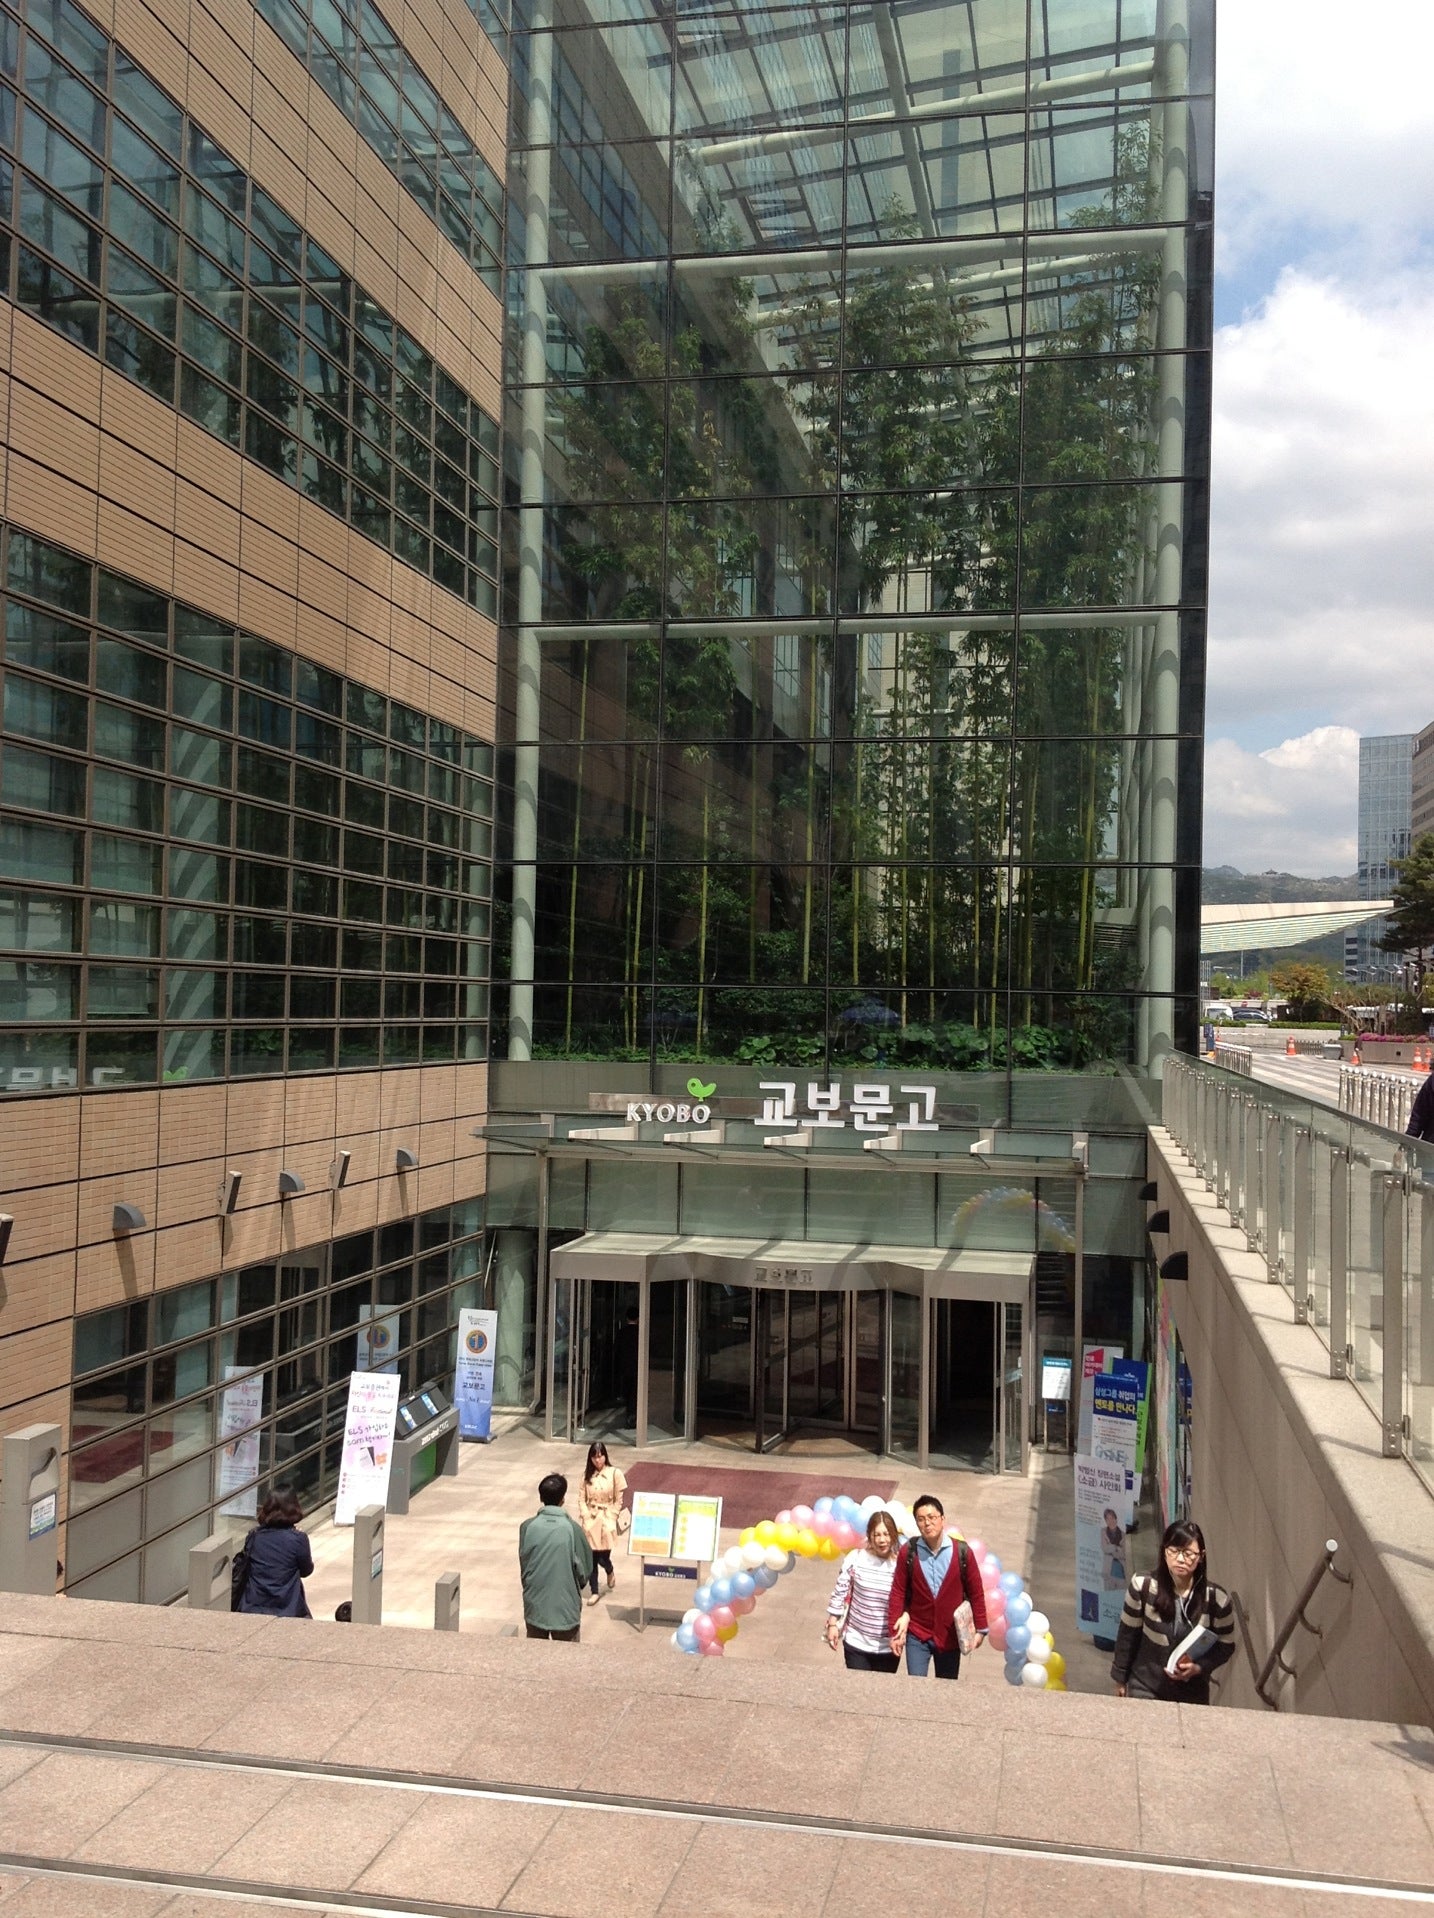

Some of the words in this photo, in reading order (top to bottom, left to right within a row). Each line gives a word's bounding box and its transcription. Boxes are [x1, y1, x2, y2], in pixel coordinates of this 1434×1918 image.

[754, 1082, 939, 1131] 교보문고
[626, 1103, 711, 1124] KYOBO
[462, 1382, 485, 1391] 교보문고
[1095, 1387, 1117, 1398] 삼성그룹
[352, 1405, 367, 1413] ELS
[348, 1426, 363, 1436] ELS
[1098, 1470, 1121, 1482] 장편소설
[1100, 1481, 1121, 1492] 사인회
